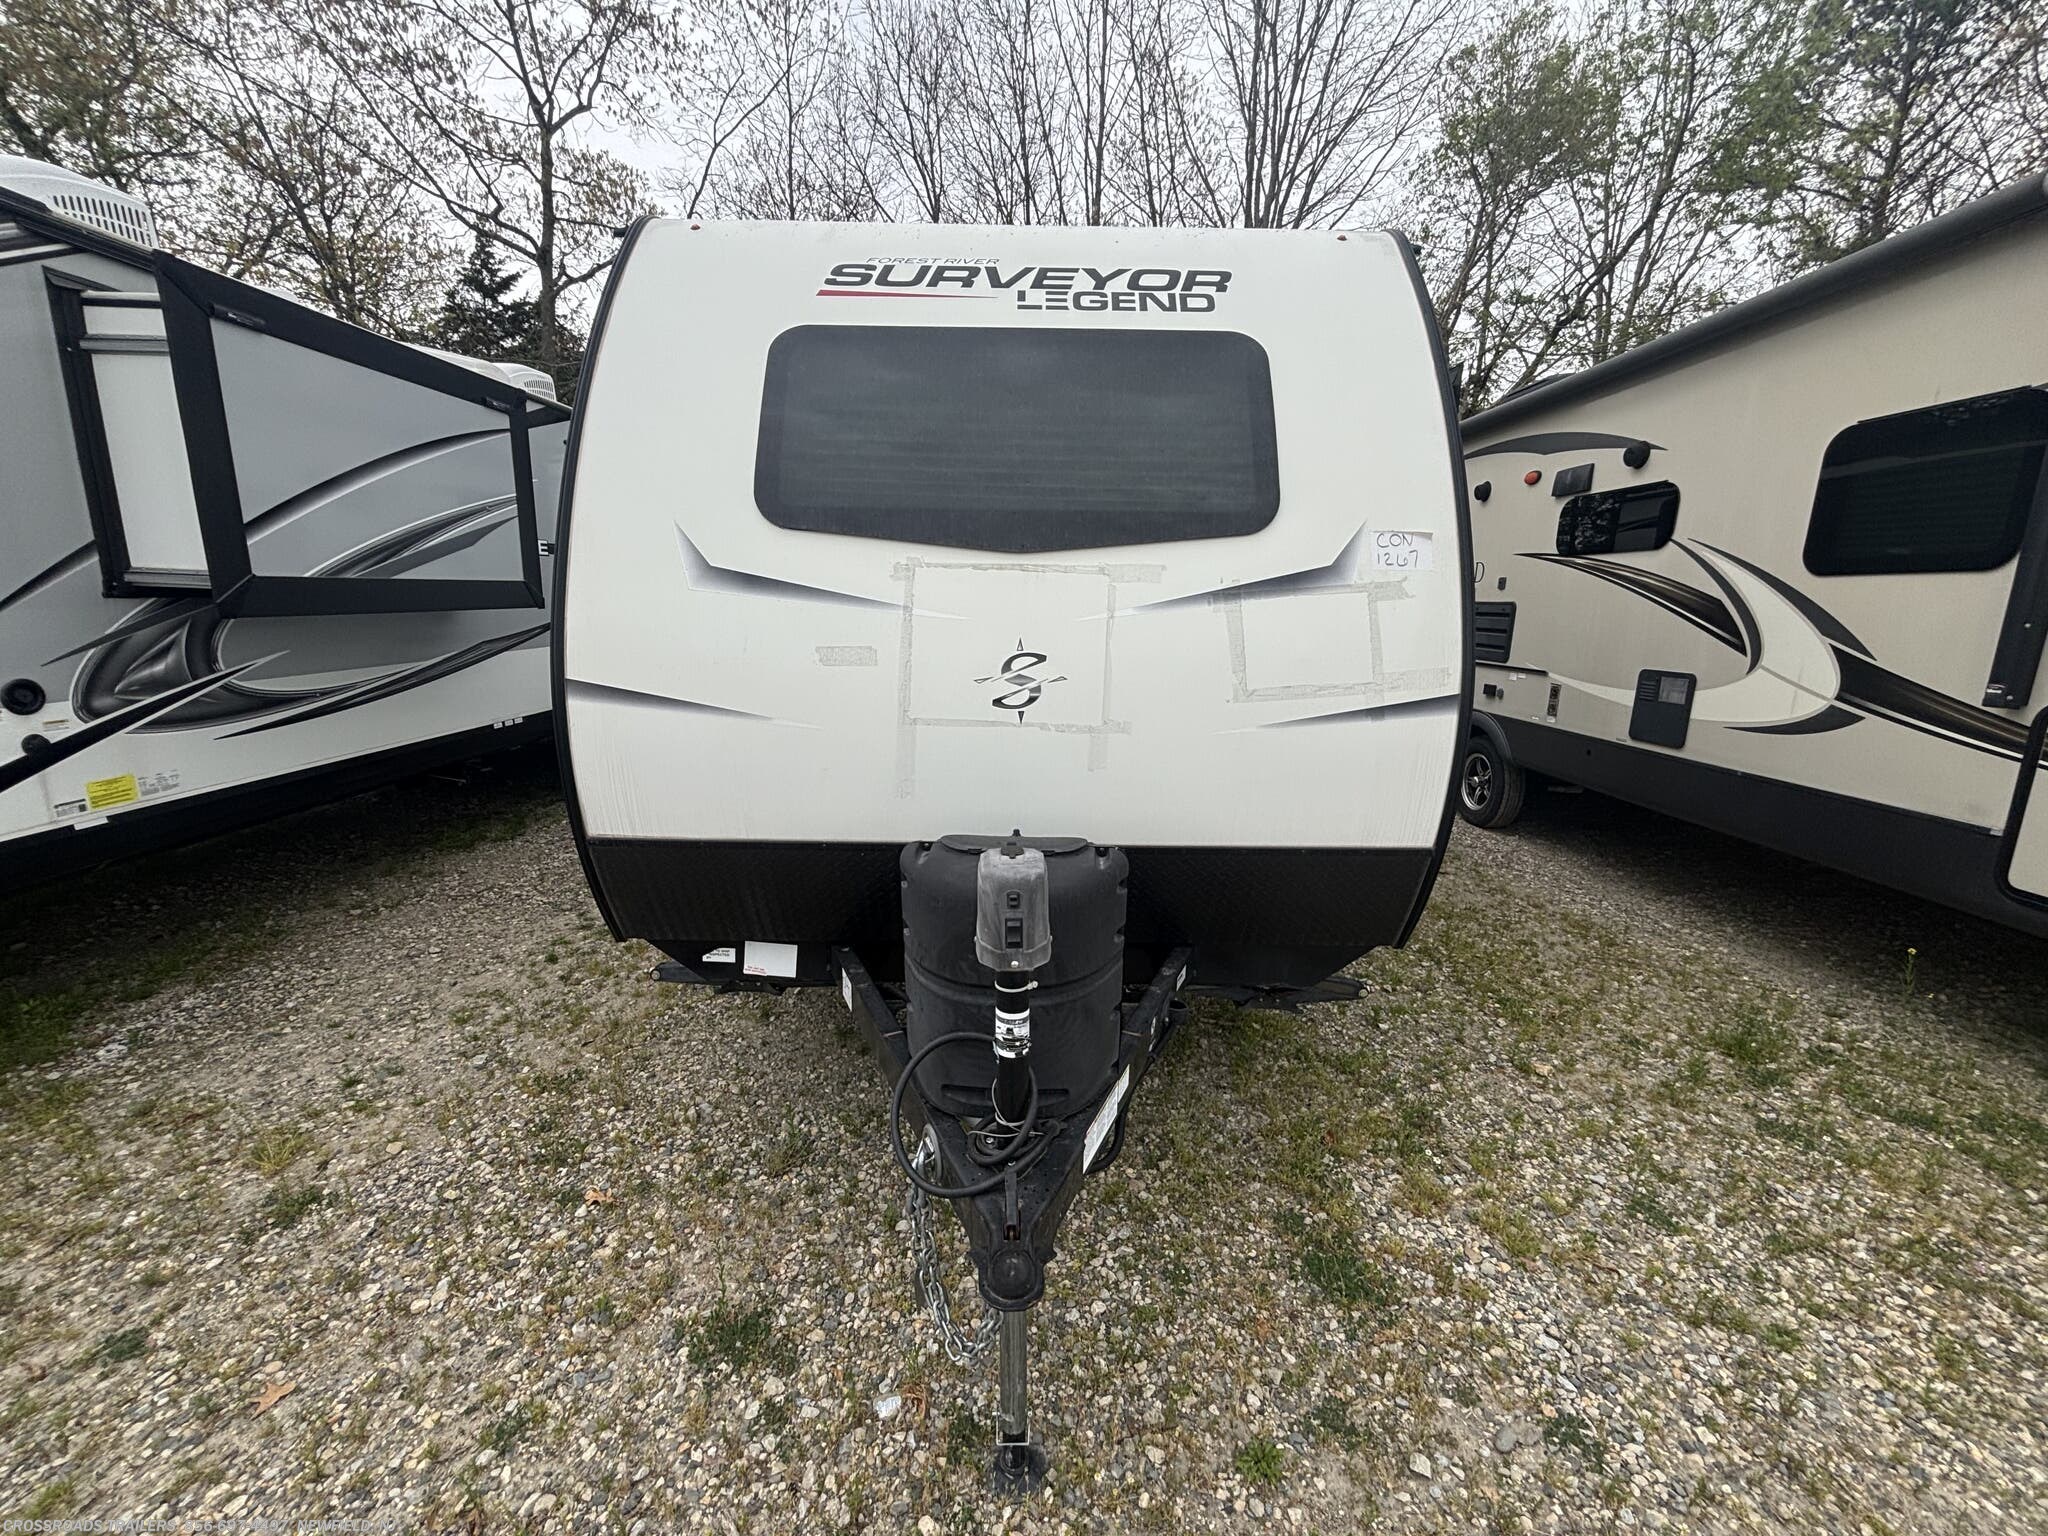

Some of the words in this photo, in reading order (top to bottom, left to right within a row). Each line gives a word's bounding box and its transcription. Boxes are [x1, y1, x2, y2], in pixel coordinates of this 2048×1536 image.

[823, 263, 1233, 293] SURVEYOR
[1017, 289, 1216, 313] LEGEND
[1376, 532, 1414, 548] CON
[1376, 550, 1419, 569] 1267
